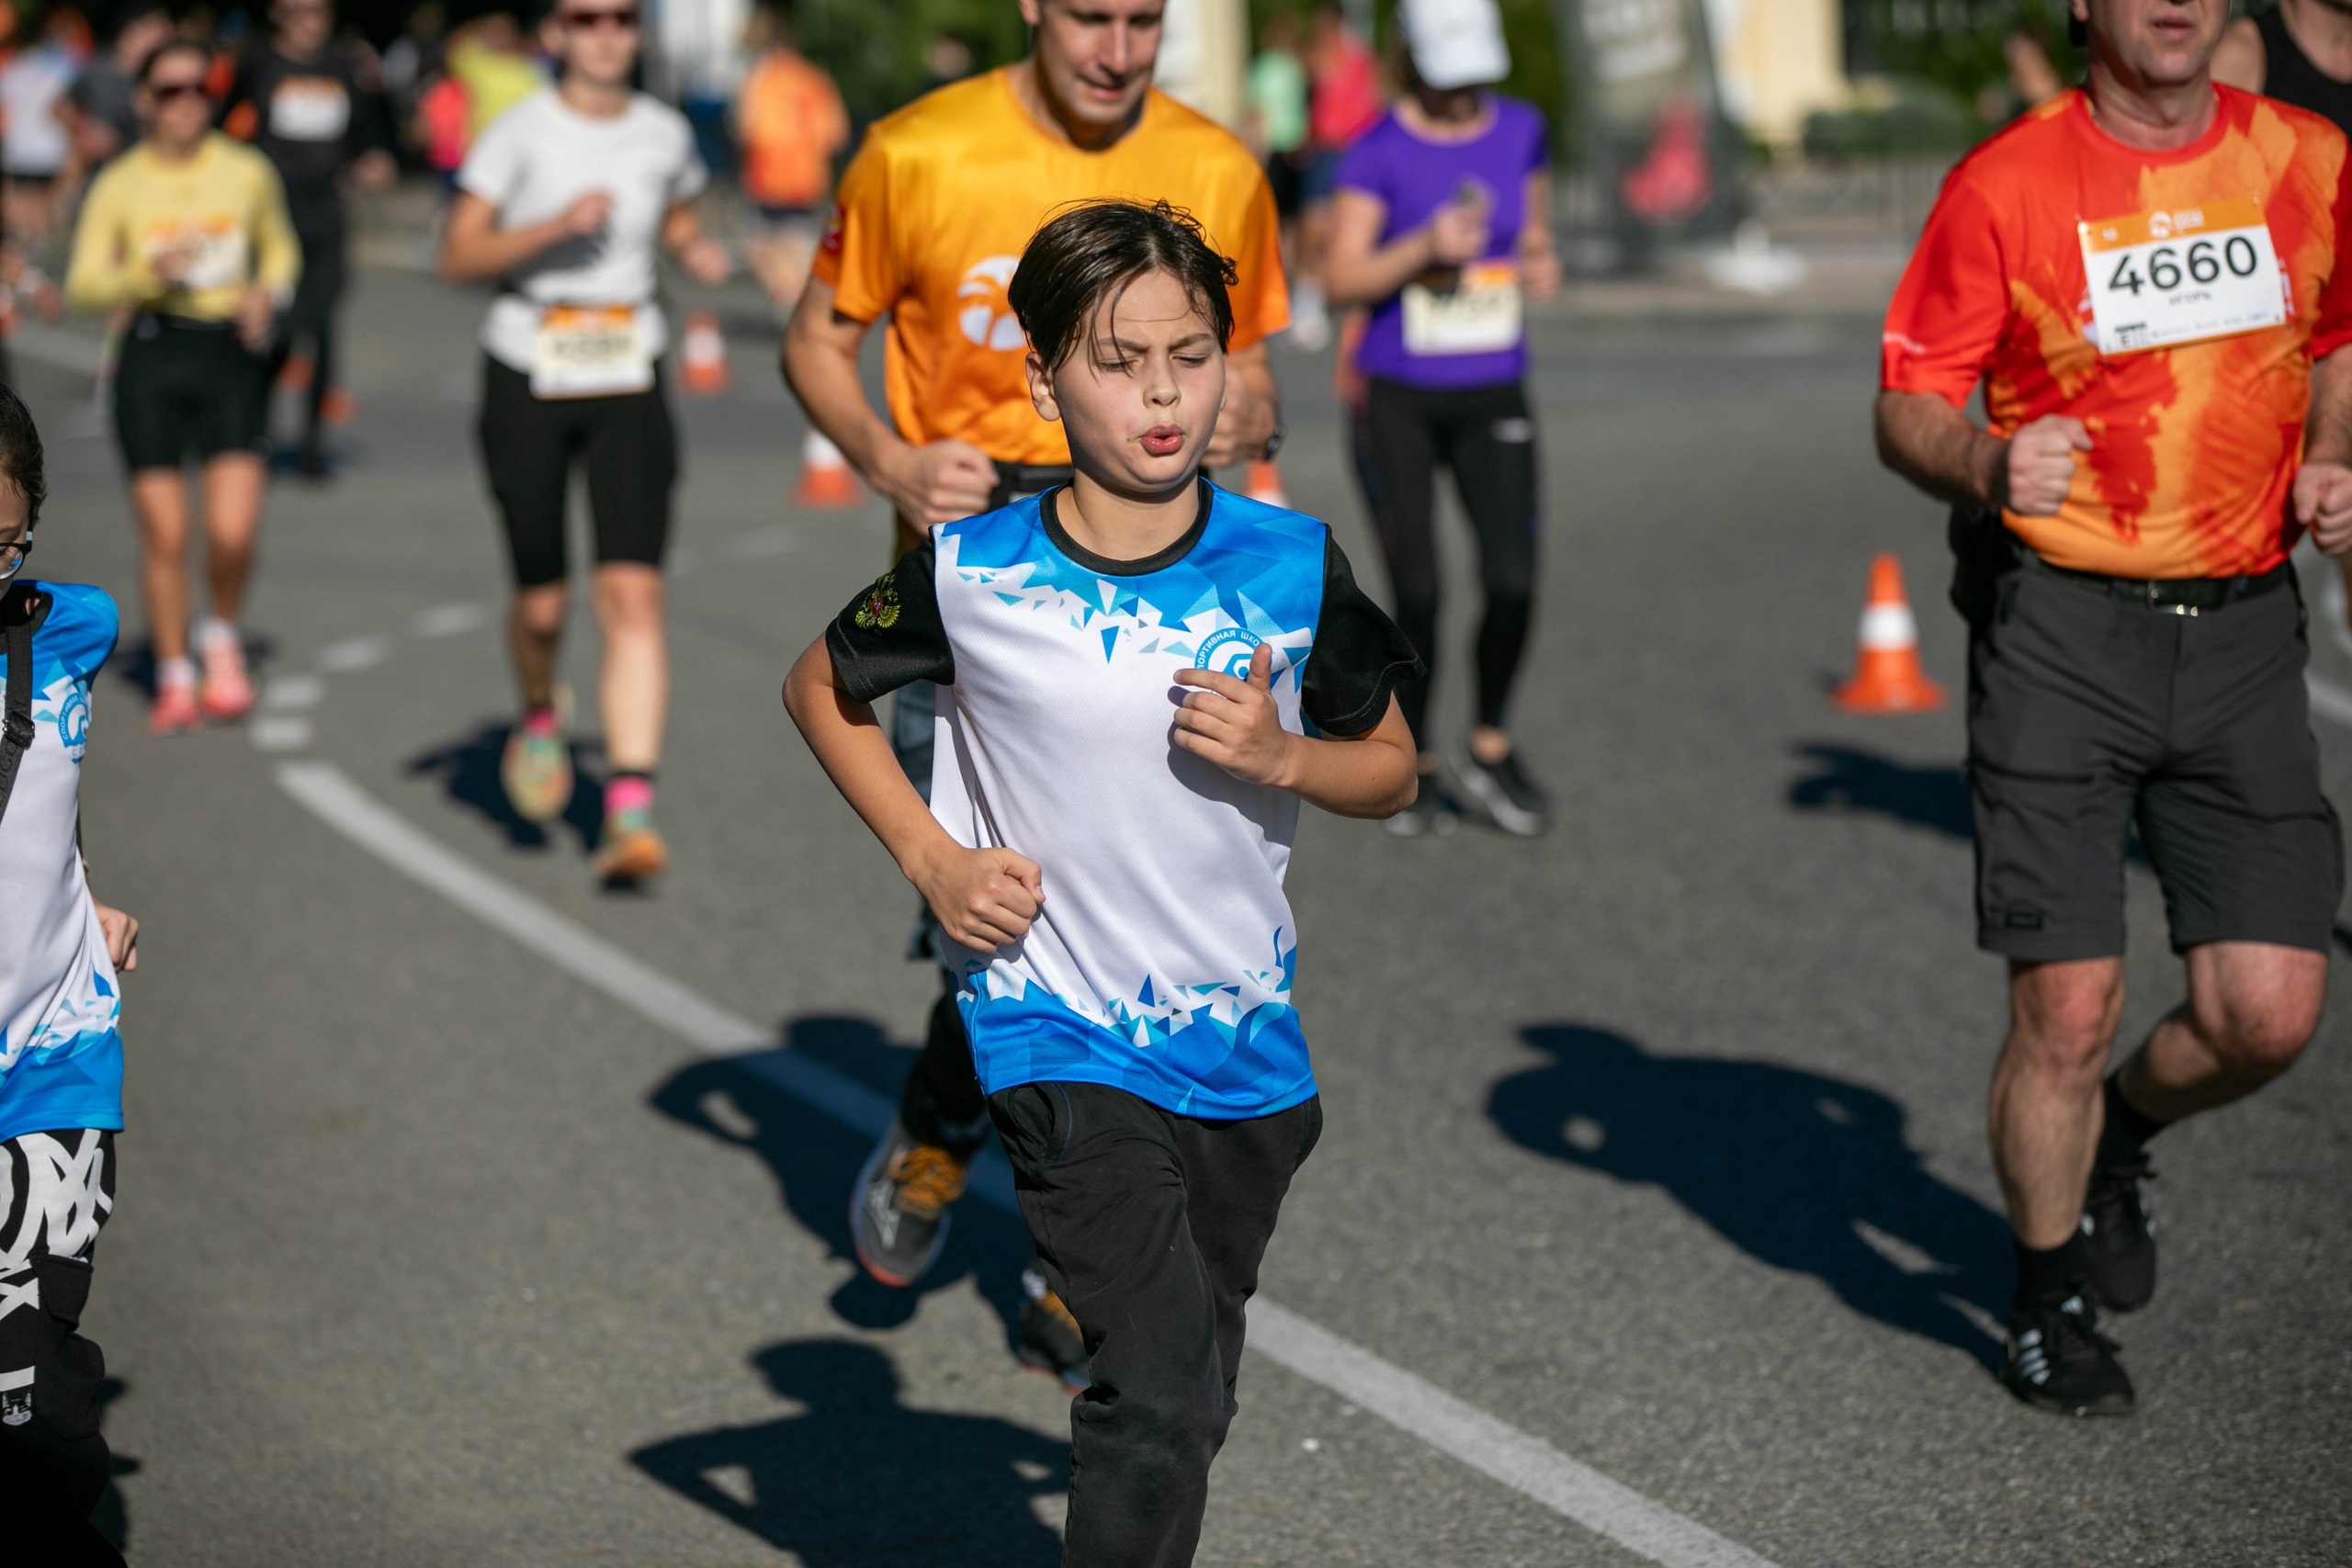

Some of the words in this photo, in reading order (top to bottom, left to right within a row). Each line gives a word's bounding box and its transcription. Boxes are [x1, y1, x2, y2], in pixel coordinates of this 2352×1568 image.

[2109, 235, 2257, 296] 4660
[1197, 629, 1237, 670] ПОРТИВНАЯ
[1240, 631, 1261, 647] ШКО
